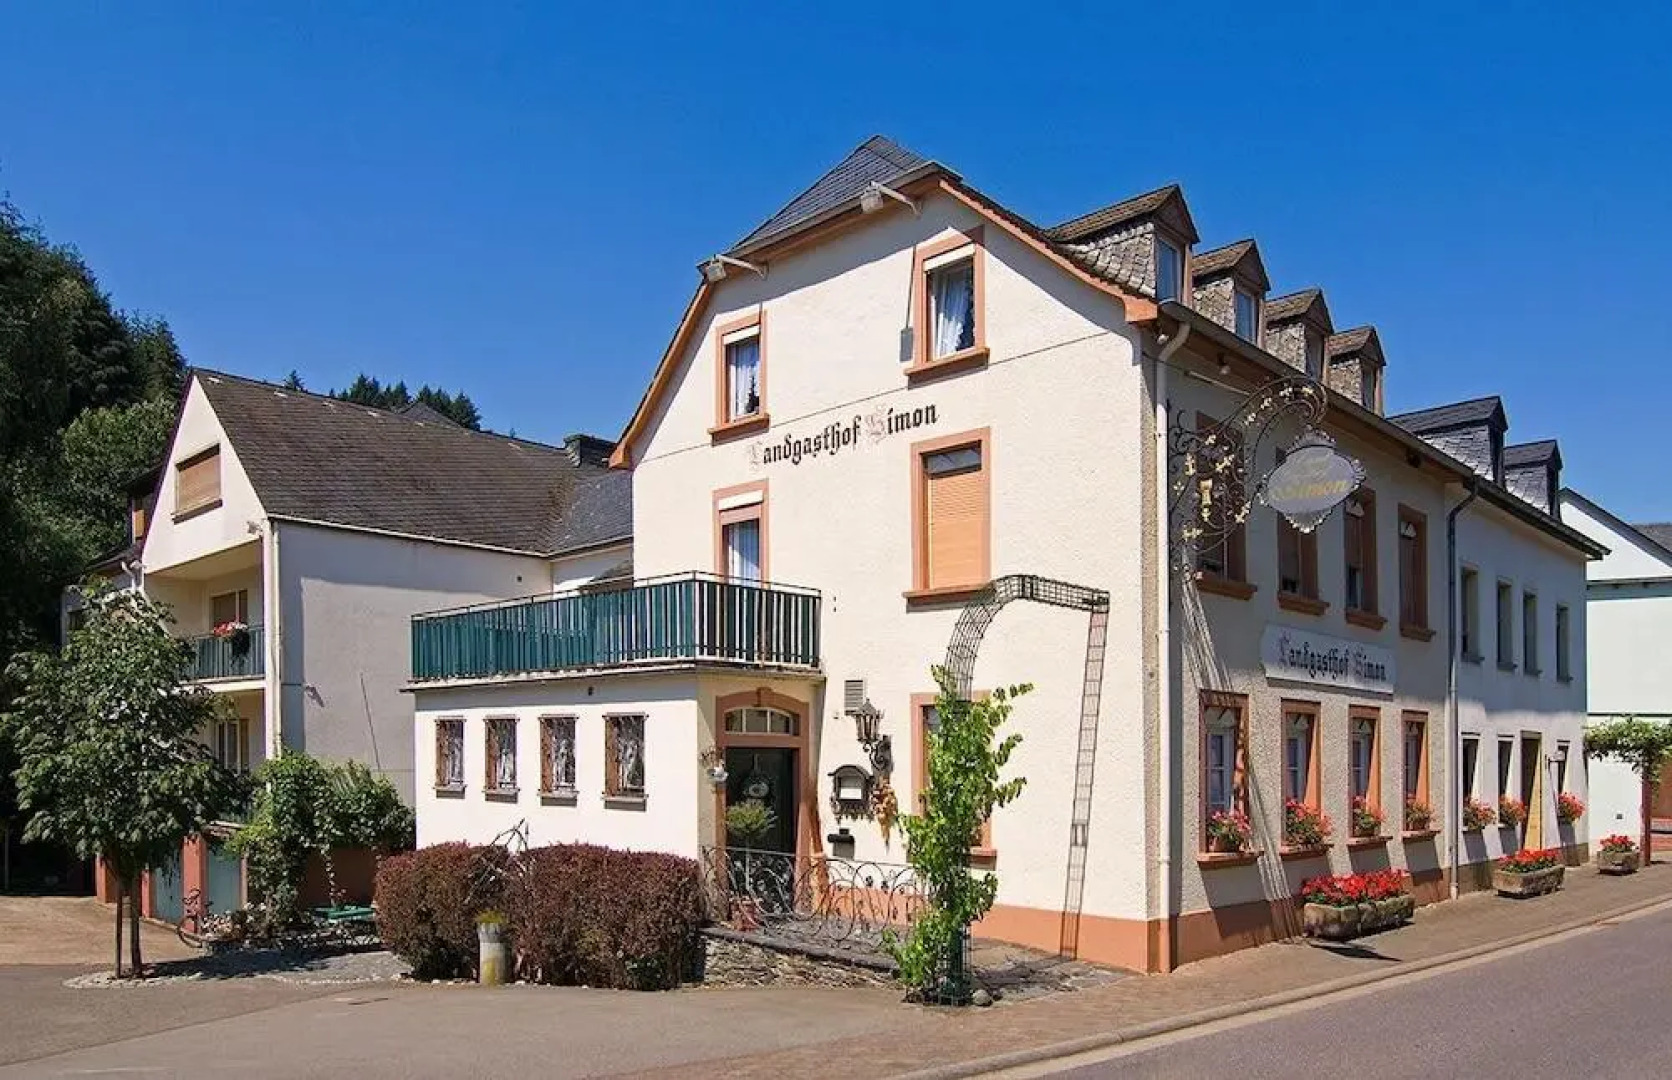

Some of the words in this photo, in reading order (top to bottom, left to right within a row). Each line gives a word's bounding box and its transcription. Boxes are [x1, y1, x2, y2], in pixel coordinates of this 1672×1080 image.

[750, 414, 862, 467] Landgasthof
[865, 403, 938, 443] Simon
[1279, 631, 1349, 679] Landgasthof
[1352, 645, 1387, 681] Simon
